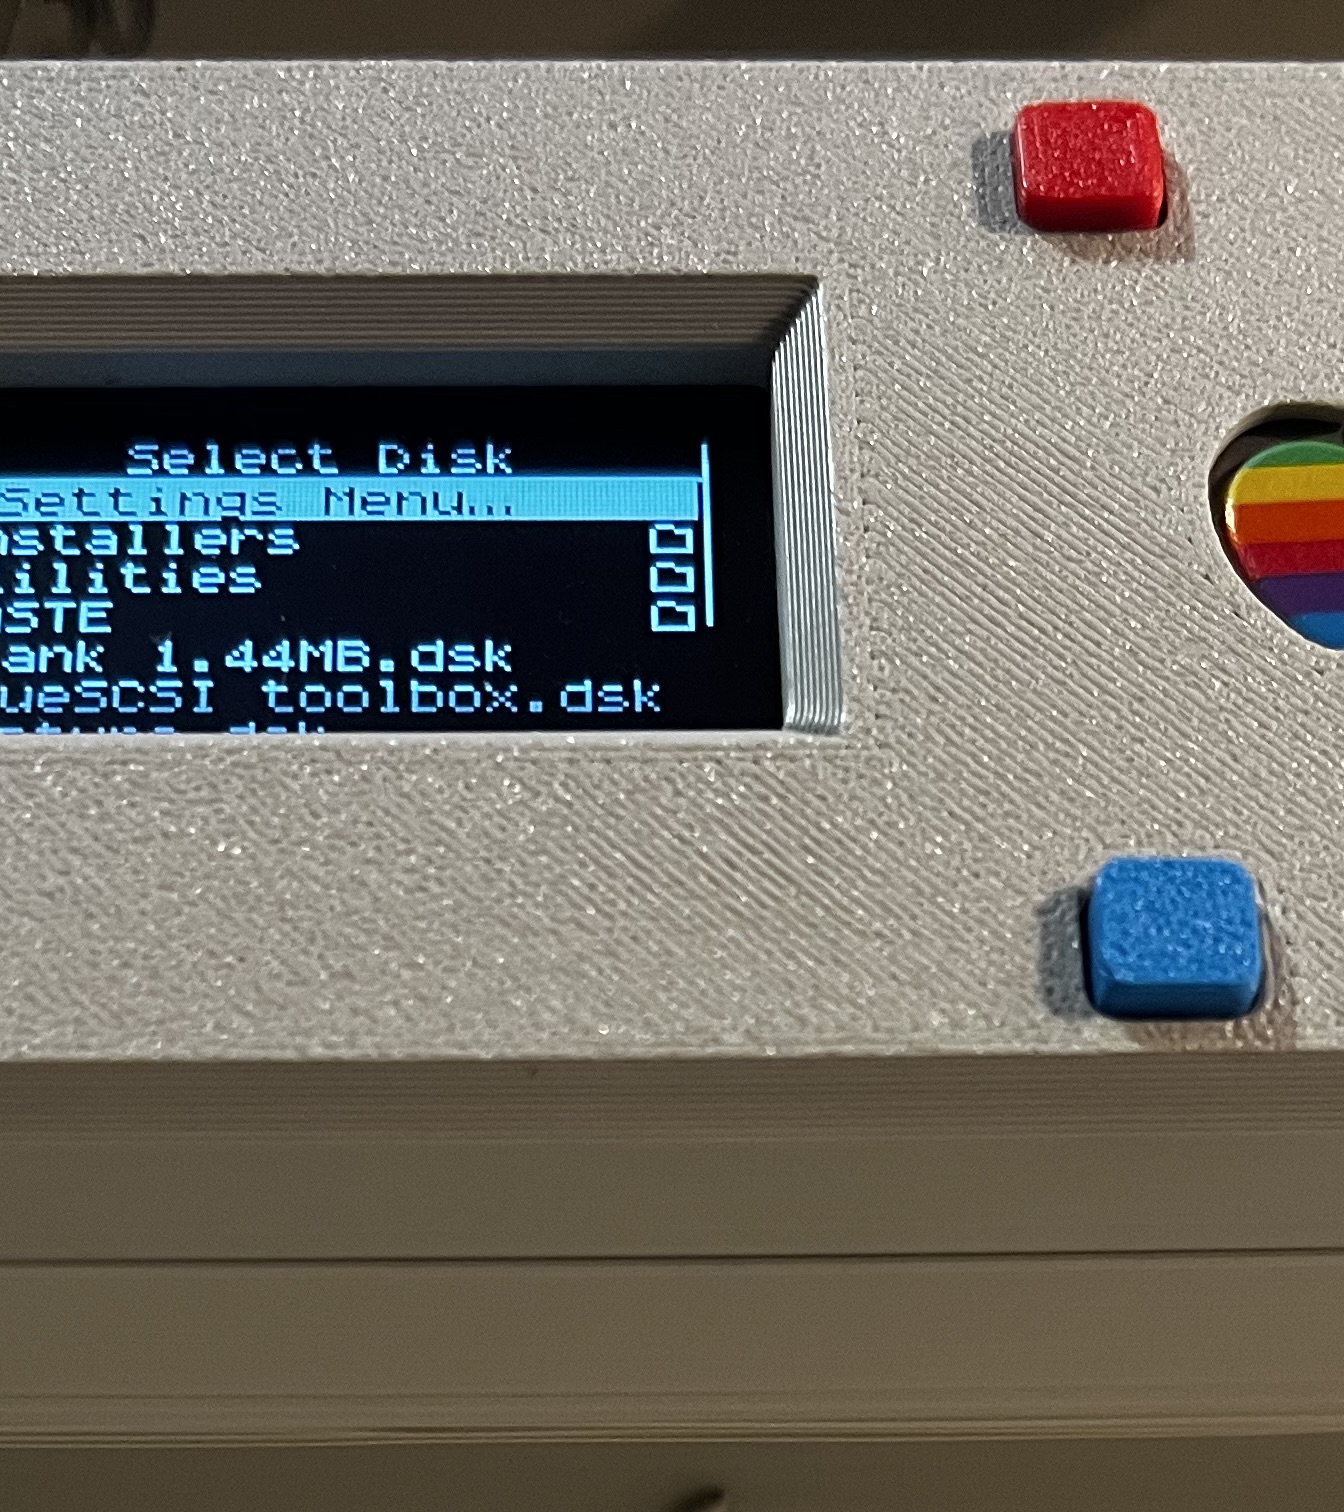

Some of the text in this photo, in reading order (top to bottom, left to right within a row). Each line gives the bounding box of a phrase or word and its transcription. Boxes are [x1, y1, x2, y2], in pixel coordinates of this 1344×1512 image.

[126, 443, 513, 475] Select Disk
[324, 487, 513, 517] Menu...
[156, 641, 511, 673] 1.44MB.dsk
[261, 681, 660, 713] toolbox.dsk
